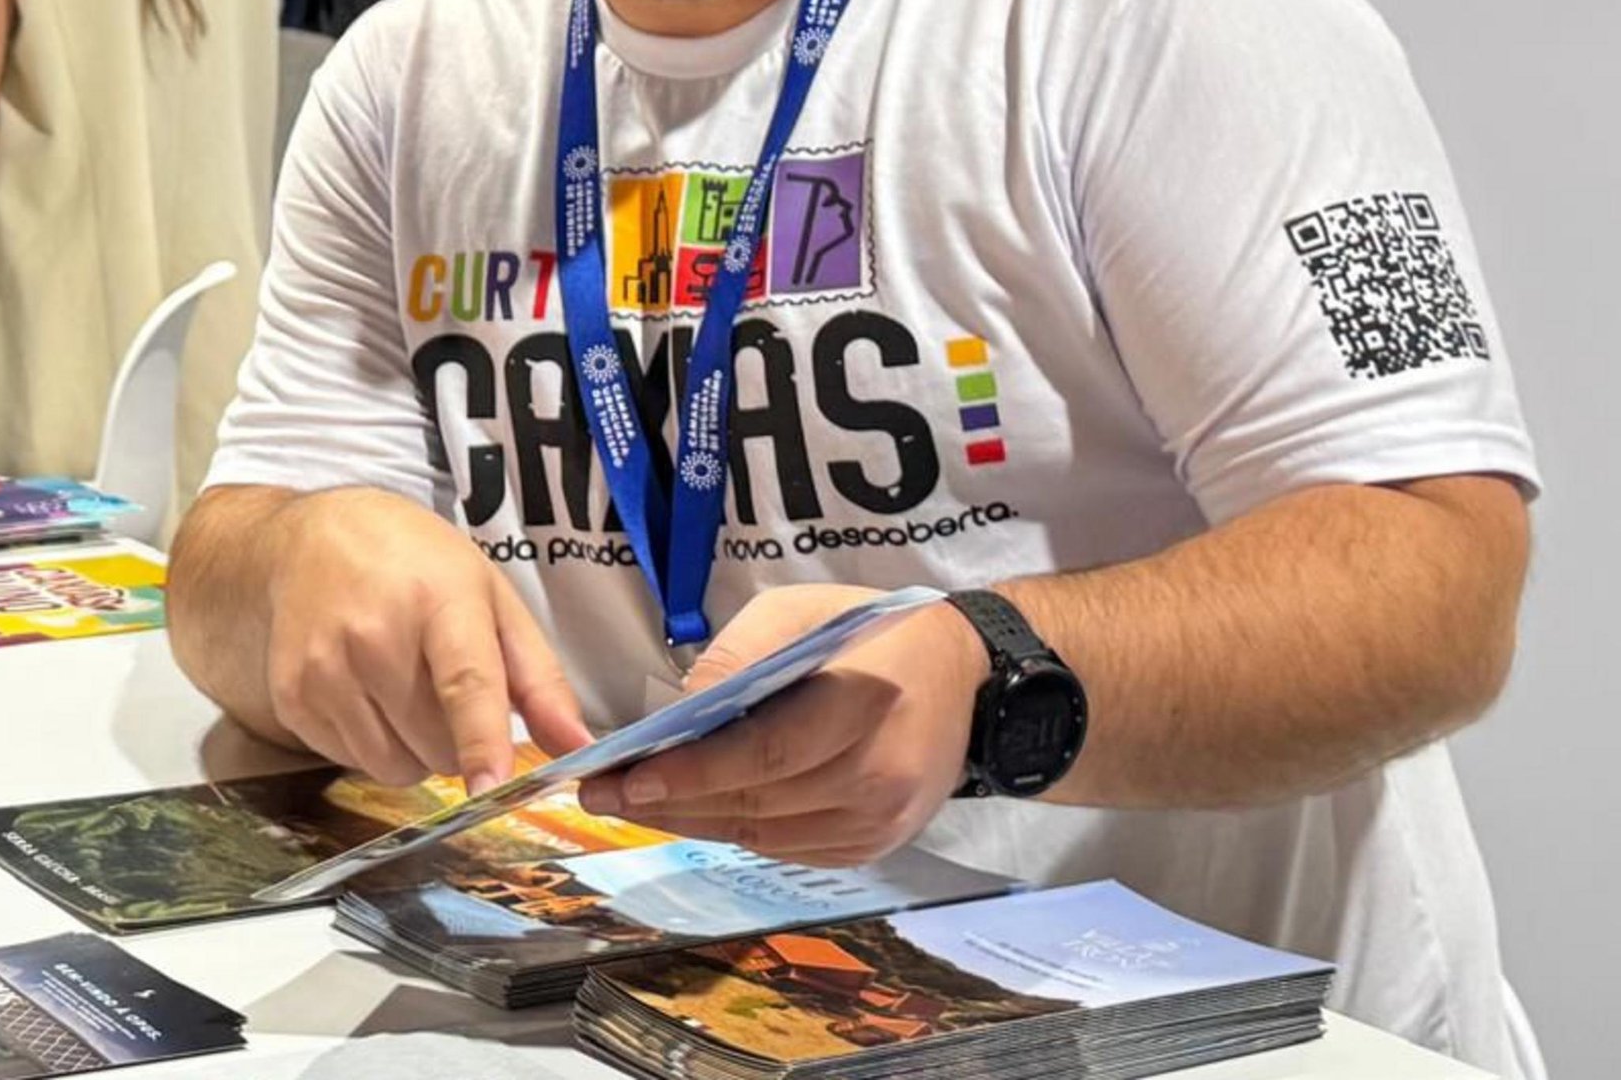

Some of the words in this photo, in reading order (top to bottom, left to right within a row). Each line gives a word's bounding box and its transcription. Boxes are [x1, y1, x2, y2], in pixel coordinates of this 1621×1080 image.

[407, 249, 557, 322] CURT
[412, 309, 940, 532] CAXAS
[471, 533, 538, 563] ada
[722, 536, 784, 561] nova
